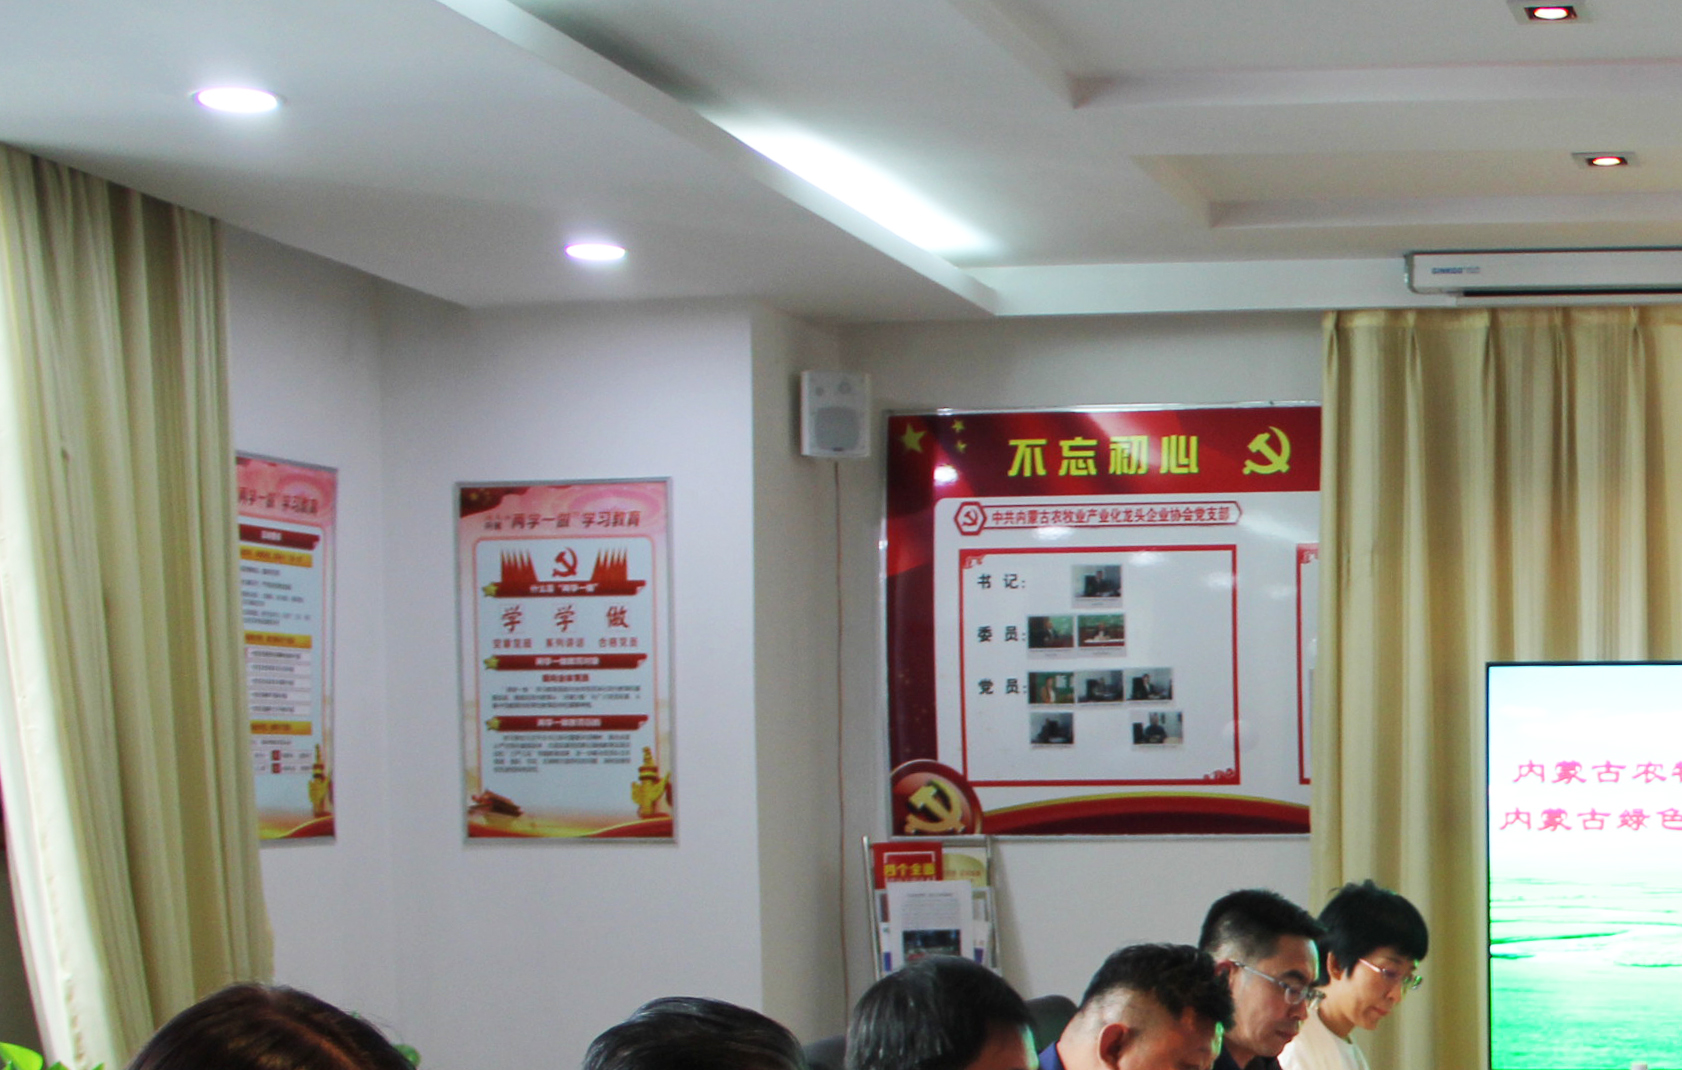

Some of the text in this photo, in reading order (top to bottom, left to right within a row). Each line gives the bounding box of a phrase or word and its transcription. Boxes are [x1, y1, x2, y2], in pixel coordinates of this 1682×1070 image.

[1007, 434, 1200, 477] 不忘初心
[992, 506, 1231, 525] 中共内蒙古农牧业产业化龙头企业协会党支部
[502, 605, 523, 633] 学
[554, 605, 576, 633] 学
